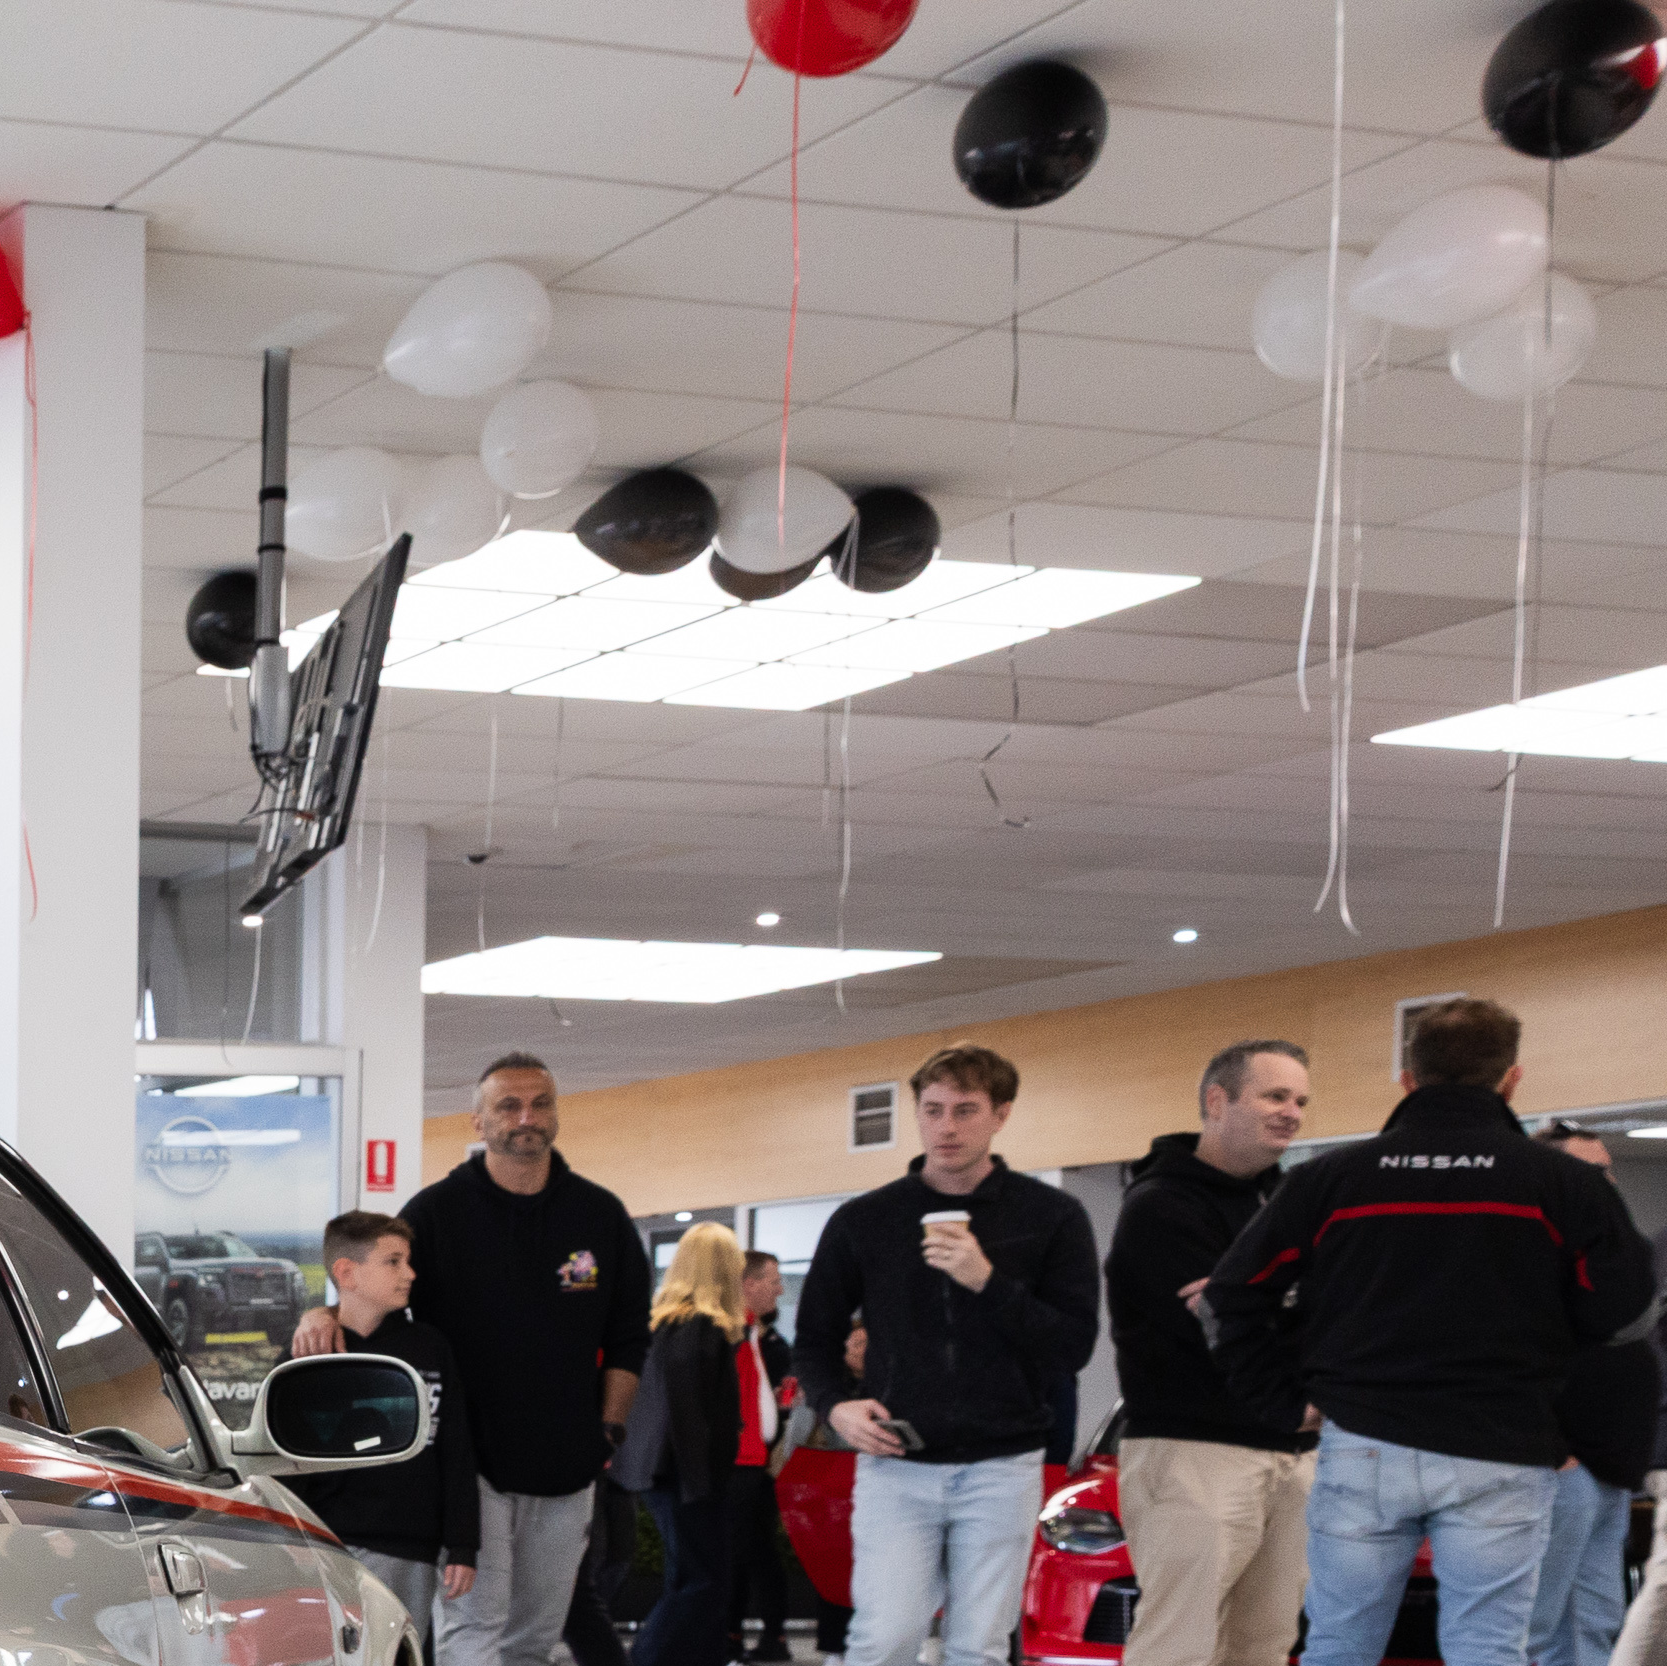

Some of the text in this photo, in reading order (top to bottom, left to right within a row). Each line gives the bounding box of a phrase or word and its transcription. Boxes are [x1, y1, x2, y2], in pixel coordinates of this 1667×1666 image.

[144, 1147, 231, 1164] NISSAN
[1378, 1154, 1495, 1170] NISSAN
[203, 1379, 263, 1401] avar
